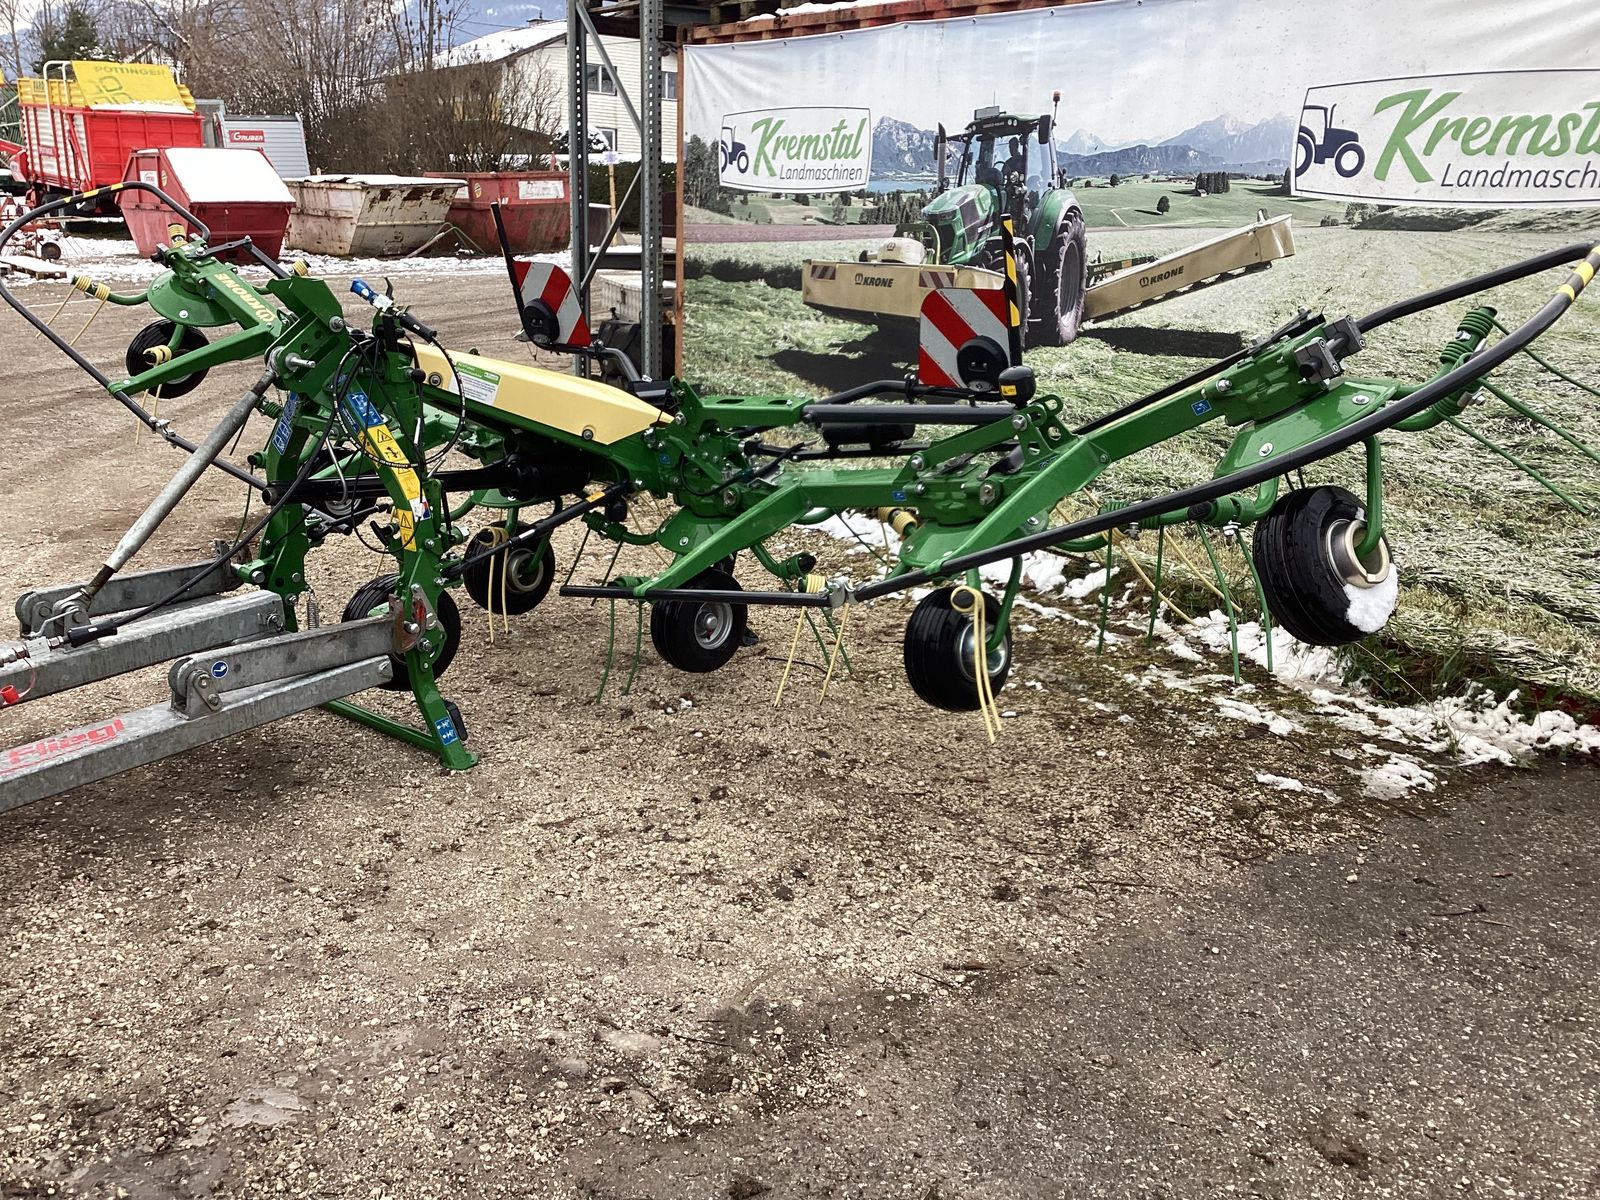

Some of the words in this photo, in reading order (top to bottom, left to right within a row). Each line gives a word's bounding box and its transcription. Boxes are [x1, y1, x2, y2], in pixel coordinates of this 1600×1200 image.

[751, 117, 867, 177] Kremstal
[1373, 88, 1600, 183] Kremst
[779, 163, 863, 181] Landmaschinen
[1440, 161, 1600, 188] Landmasch
[862, 276, 894, 288] KRONE
[1149, 265, 1184, 285] KRONE
[214, 273, 266, 311] KRONE
[9, 719, 125, 765] Fliegl
